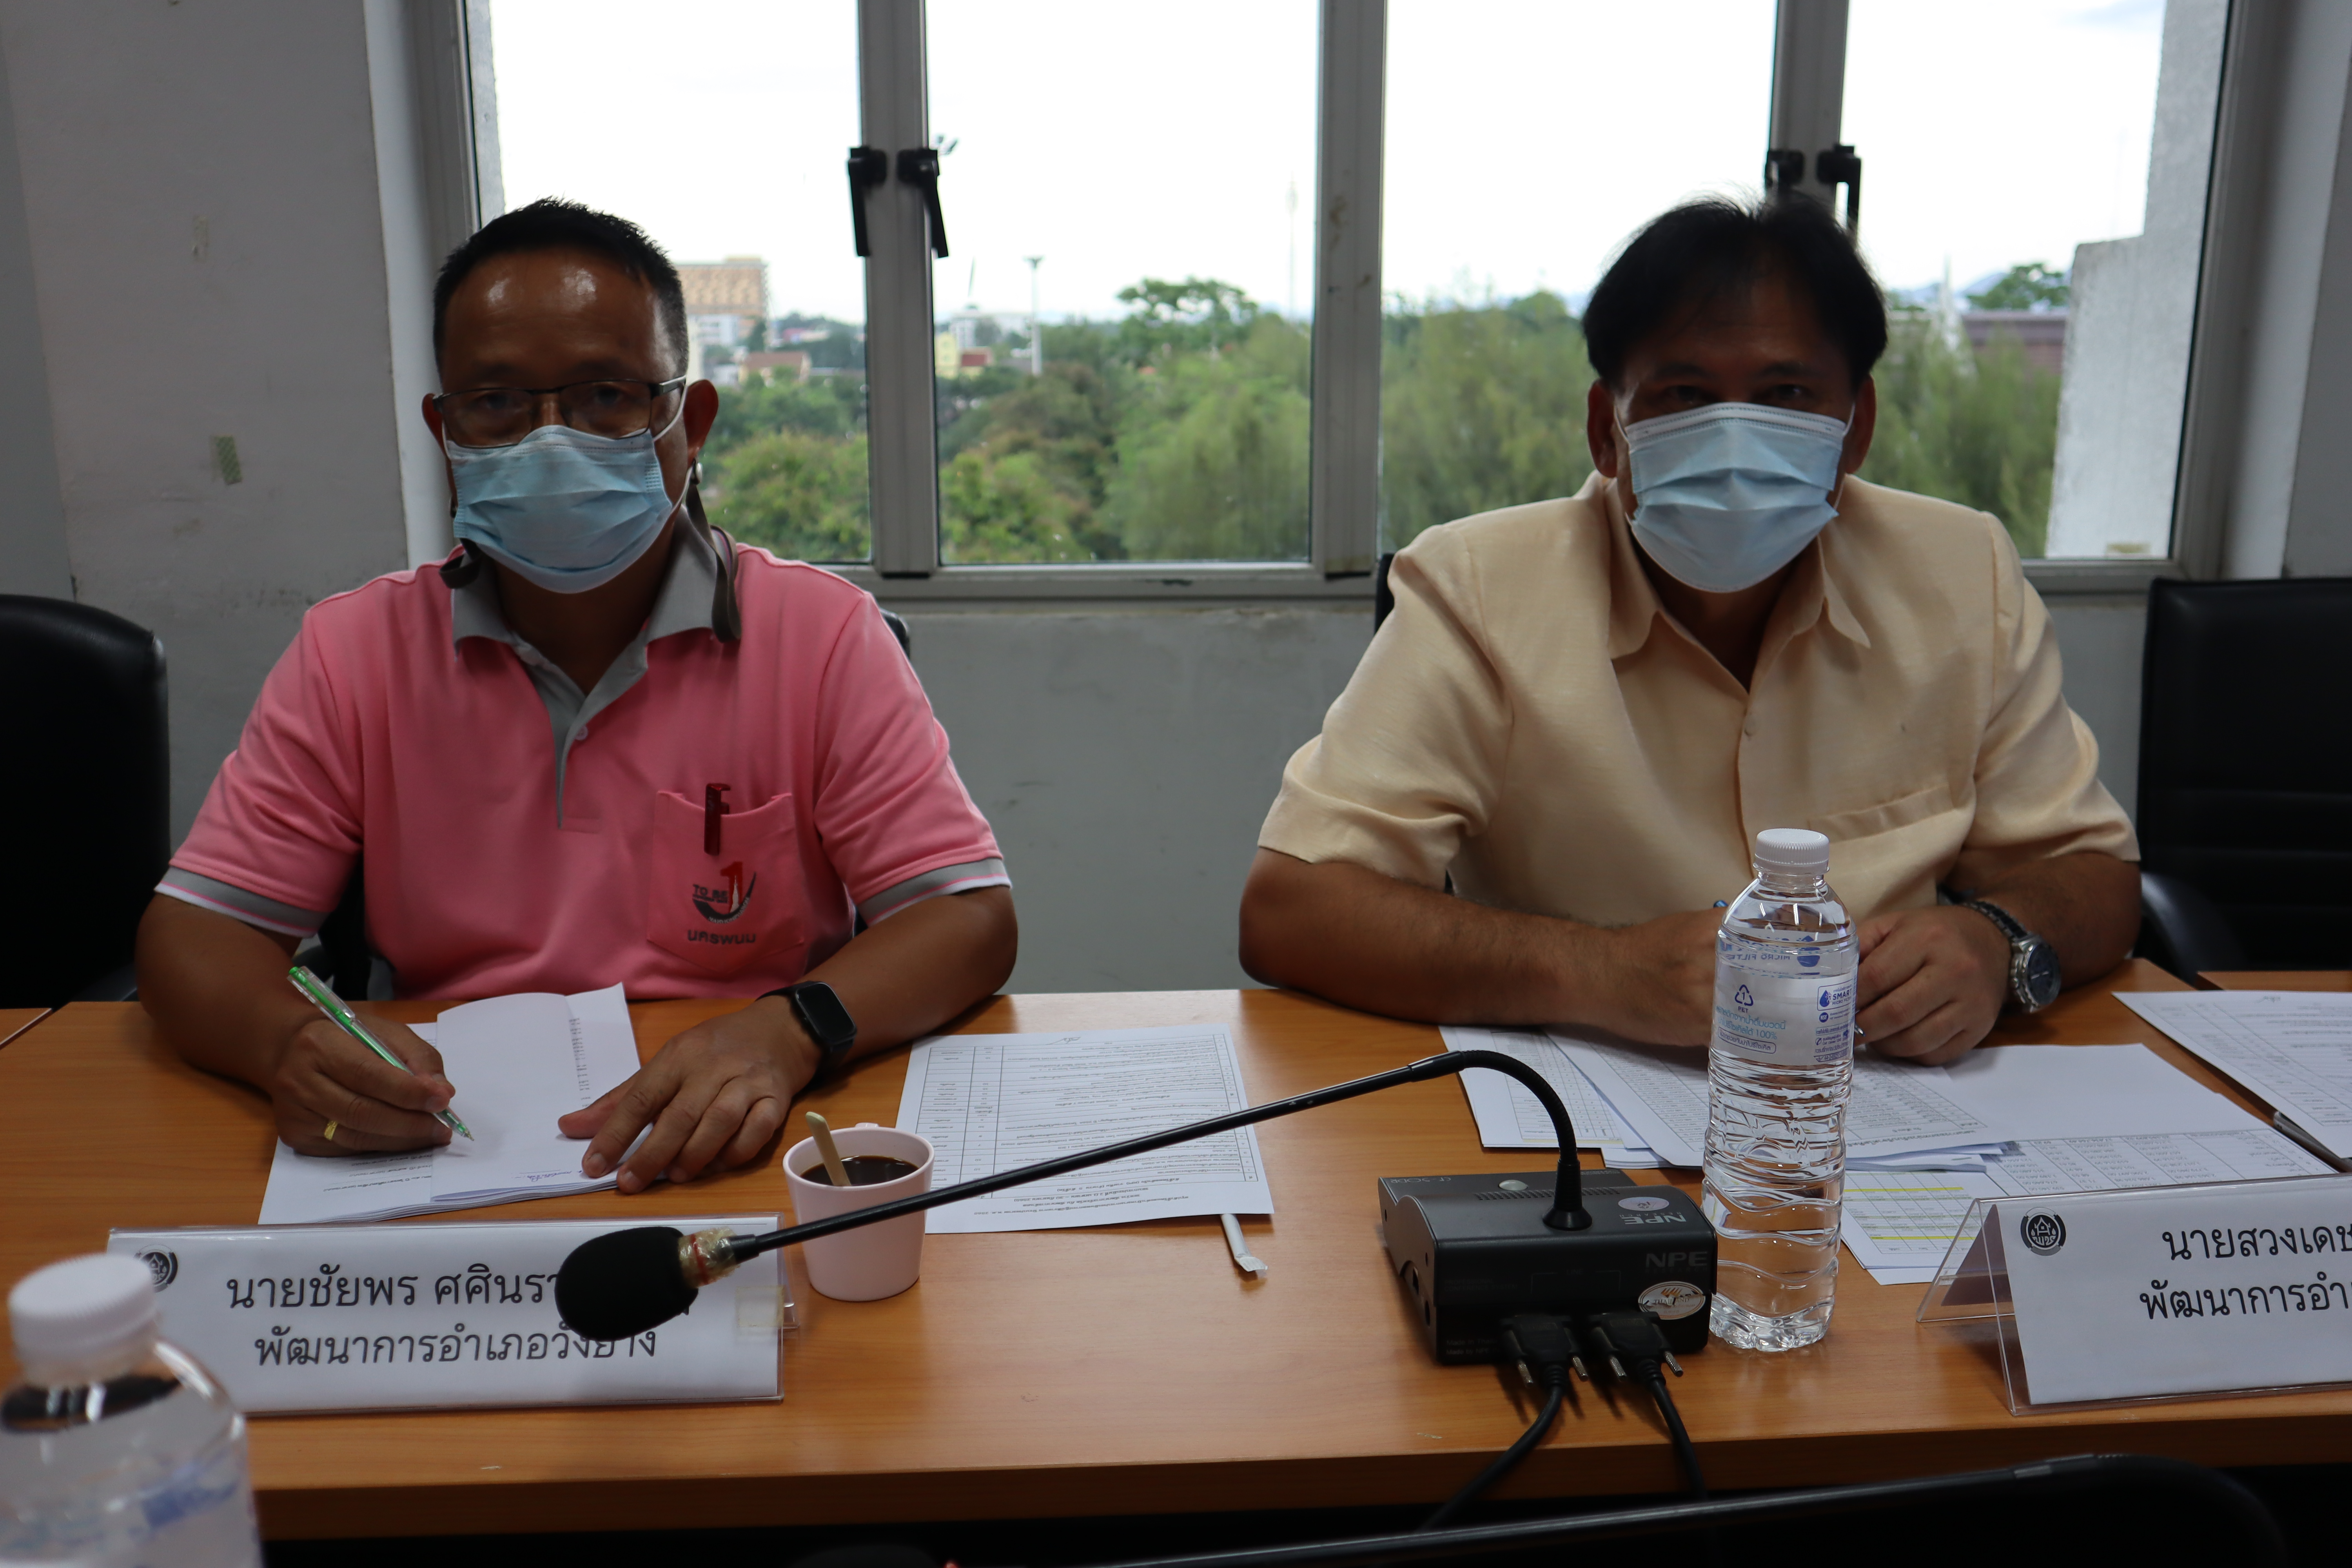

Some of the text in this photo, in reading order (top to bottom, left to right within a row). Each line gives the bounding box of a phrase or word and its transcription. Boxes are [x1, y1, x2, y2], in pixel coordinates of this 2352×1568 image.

[693, 884, 728, 898] TO BE
[688, 930, 756, 945] นครพนม
[1832, 988, 1852, 1000] SMART
[1756, 1029, 1777, 1040] 100%
[1621, 1214, 1687, 1225] NPE
[1646, 1251, 1708, 1268] NPE
[227, 1263, 419, 1308] นายชัยพร
[2139, 1271, 2352, 1319] พัฒนาการอำ
